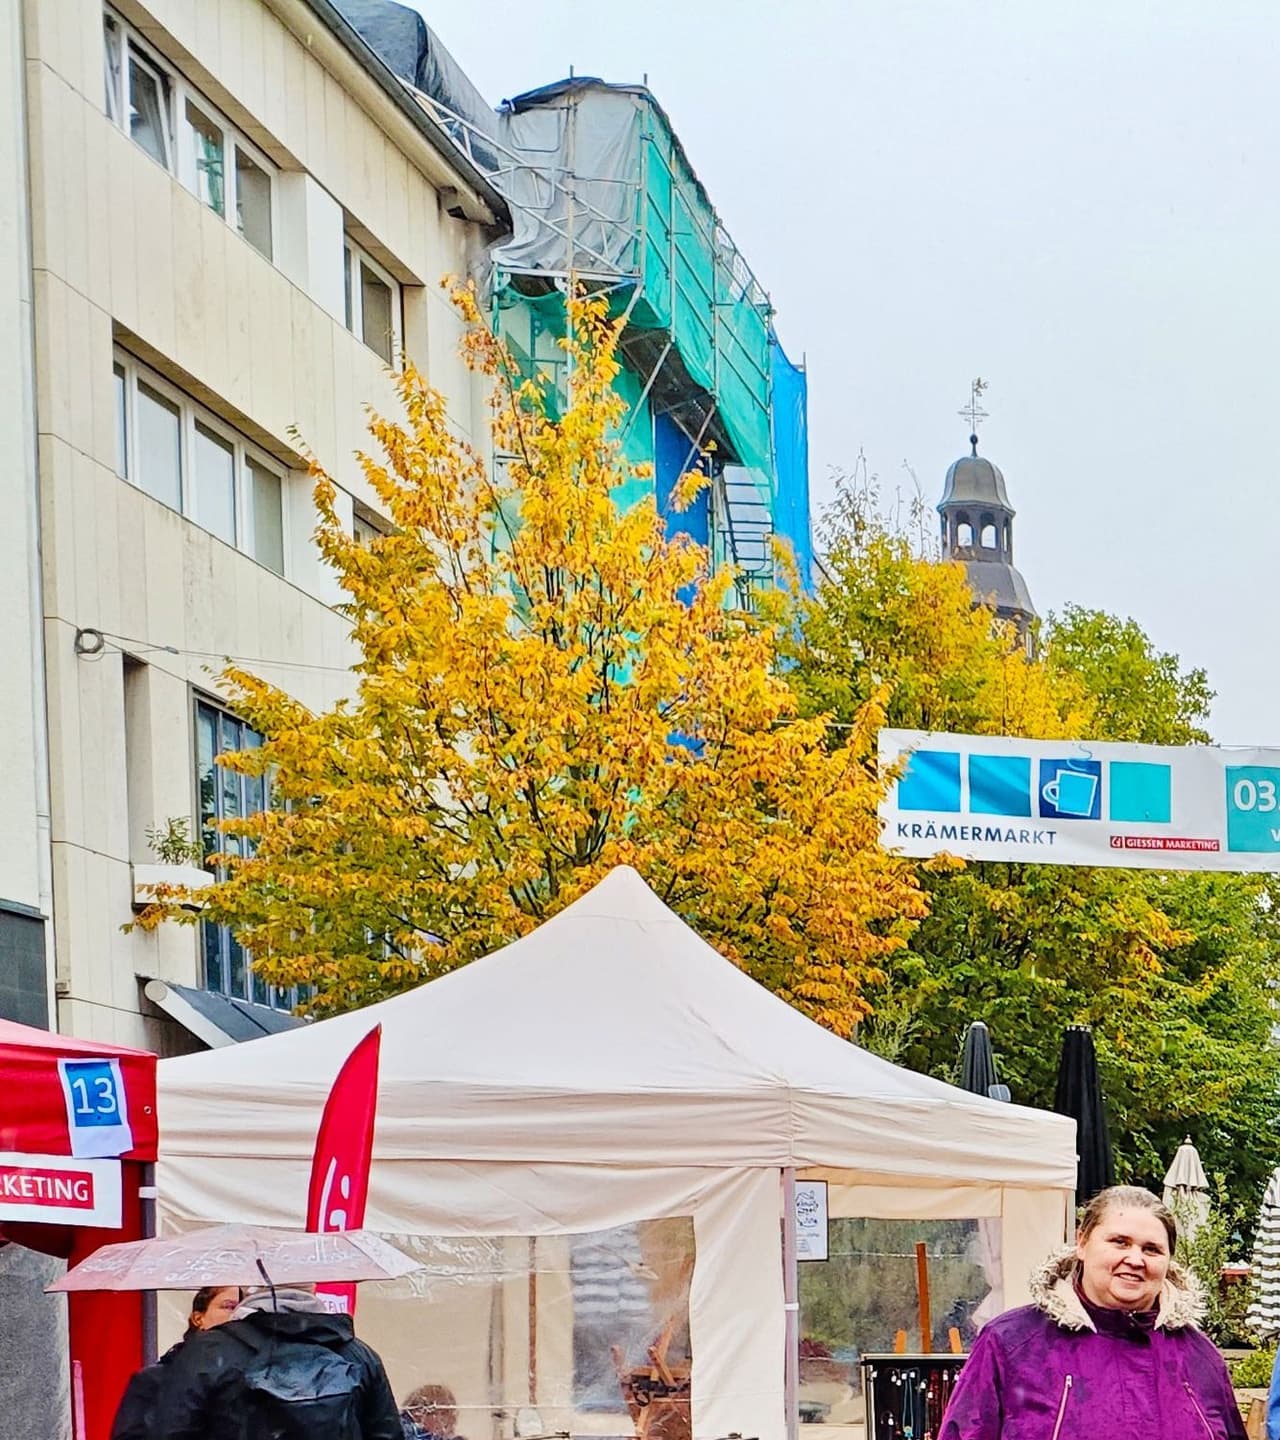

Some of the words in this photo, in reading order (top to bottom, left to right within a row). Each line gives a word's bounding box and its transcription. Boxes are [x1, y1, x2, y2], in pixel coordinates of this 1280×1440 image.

[898, 819, 1057, 845] KRÄMERMARKT
[1126, 838, 1164, 849] GIESSEN
[1165, 840, 1218, 851] MARKETING
[72, 1077, 117, 1114] 13
[0, 1174, 89, 1202] KETING
